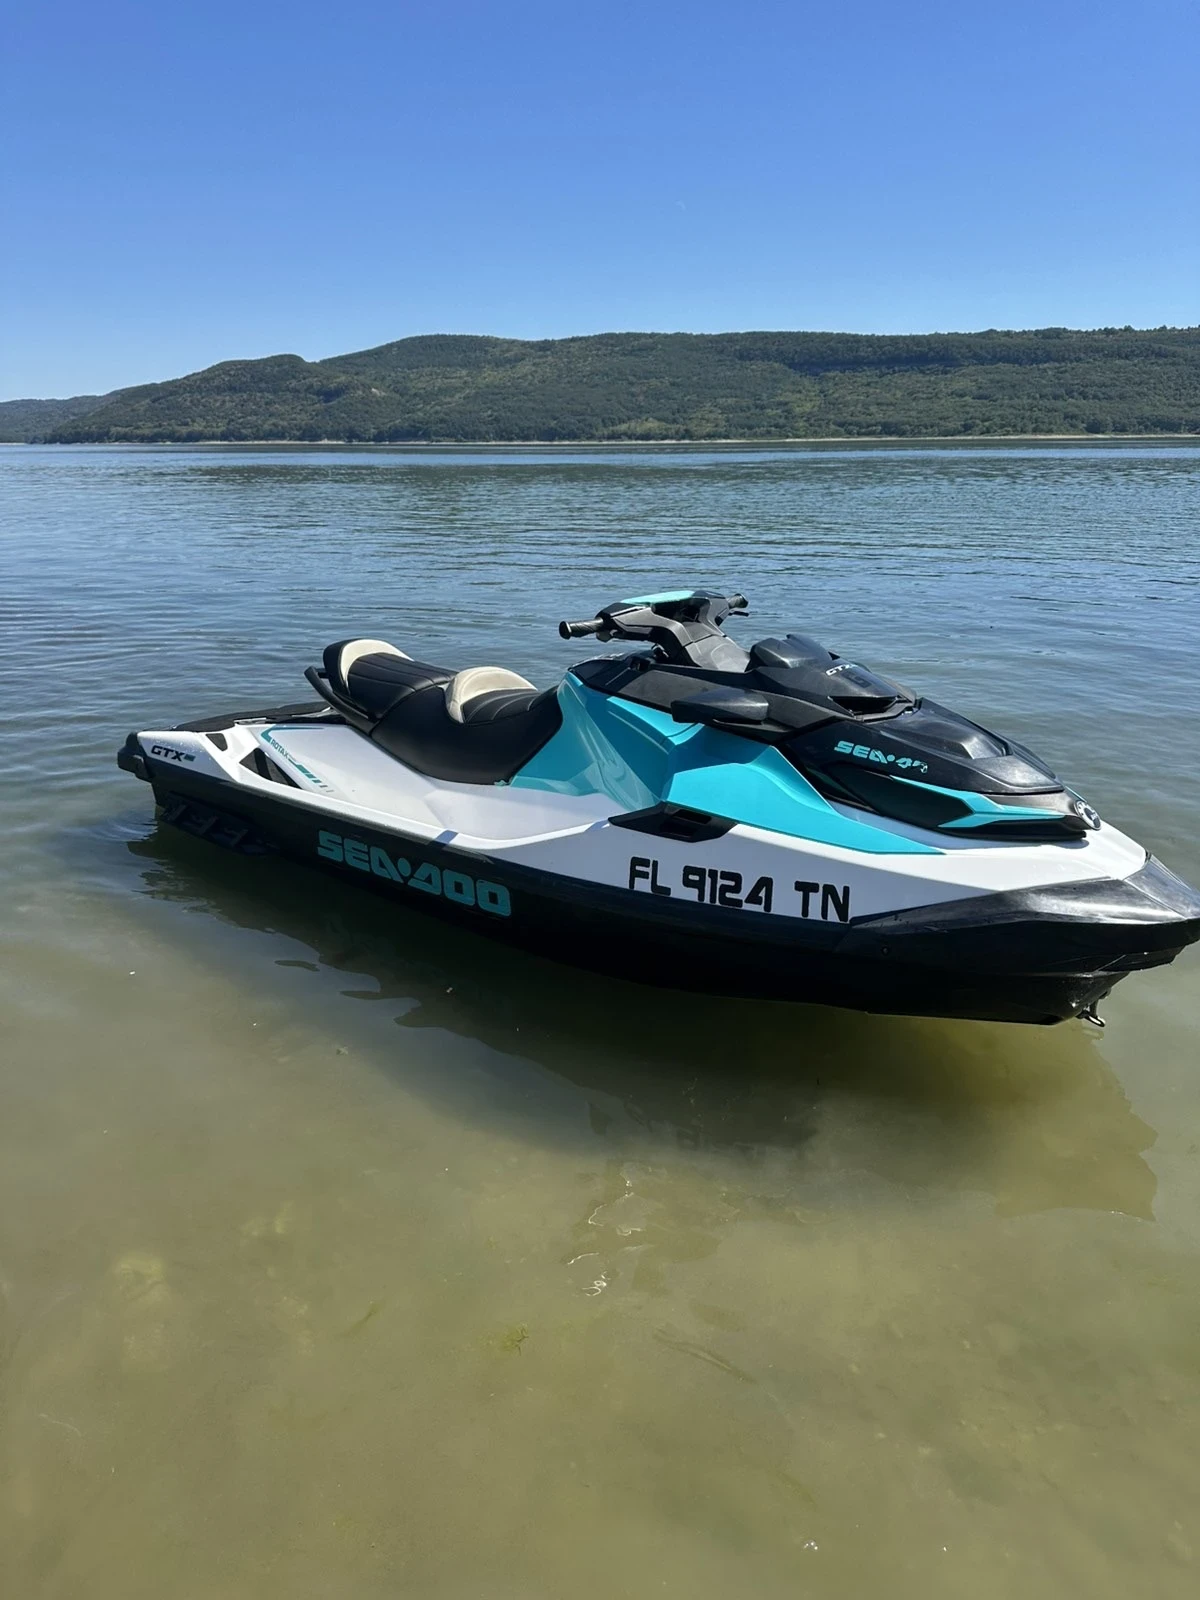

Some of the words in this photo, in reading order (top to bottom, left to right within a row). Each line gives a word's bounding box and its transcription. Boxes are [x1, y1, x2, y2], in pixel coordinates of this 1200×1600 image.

[151, 744, 185, 762] GTX
[270, 739, 289, 760] ROTAX
[629, 856, 672, 896] FL
[682, 865, 774, 913] 9124
[794, 880, 851, 923] TN
